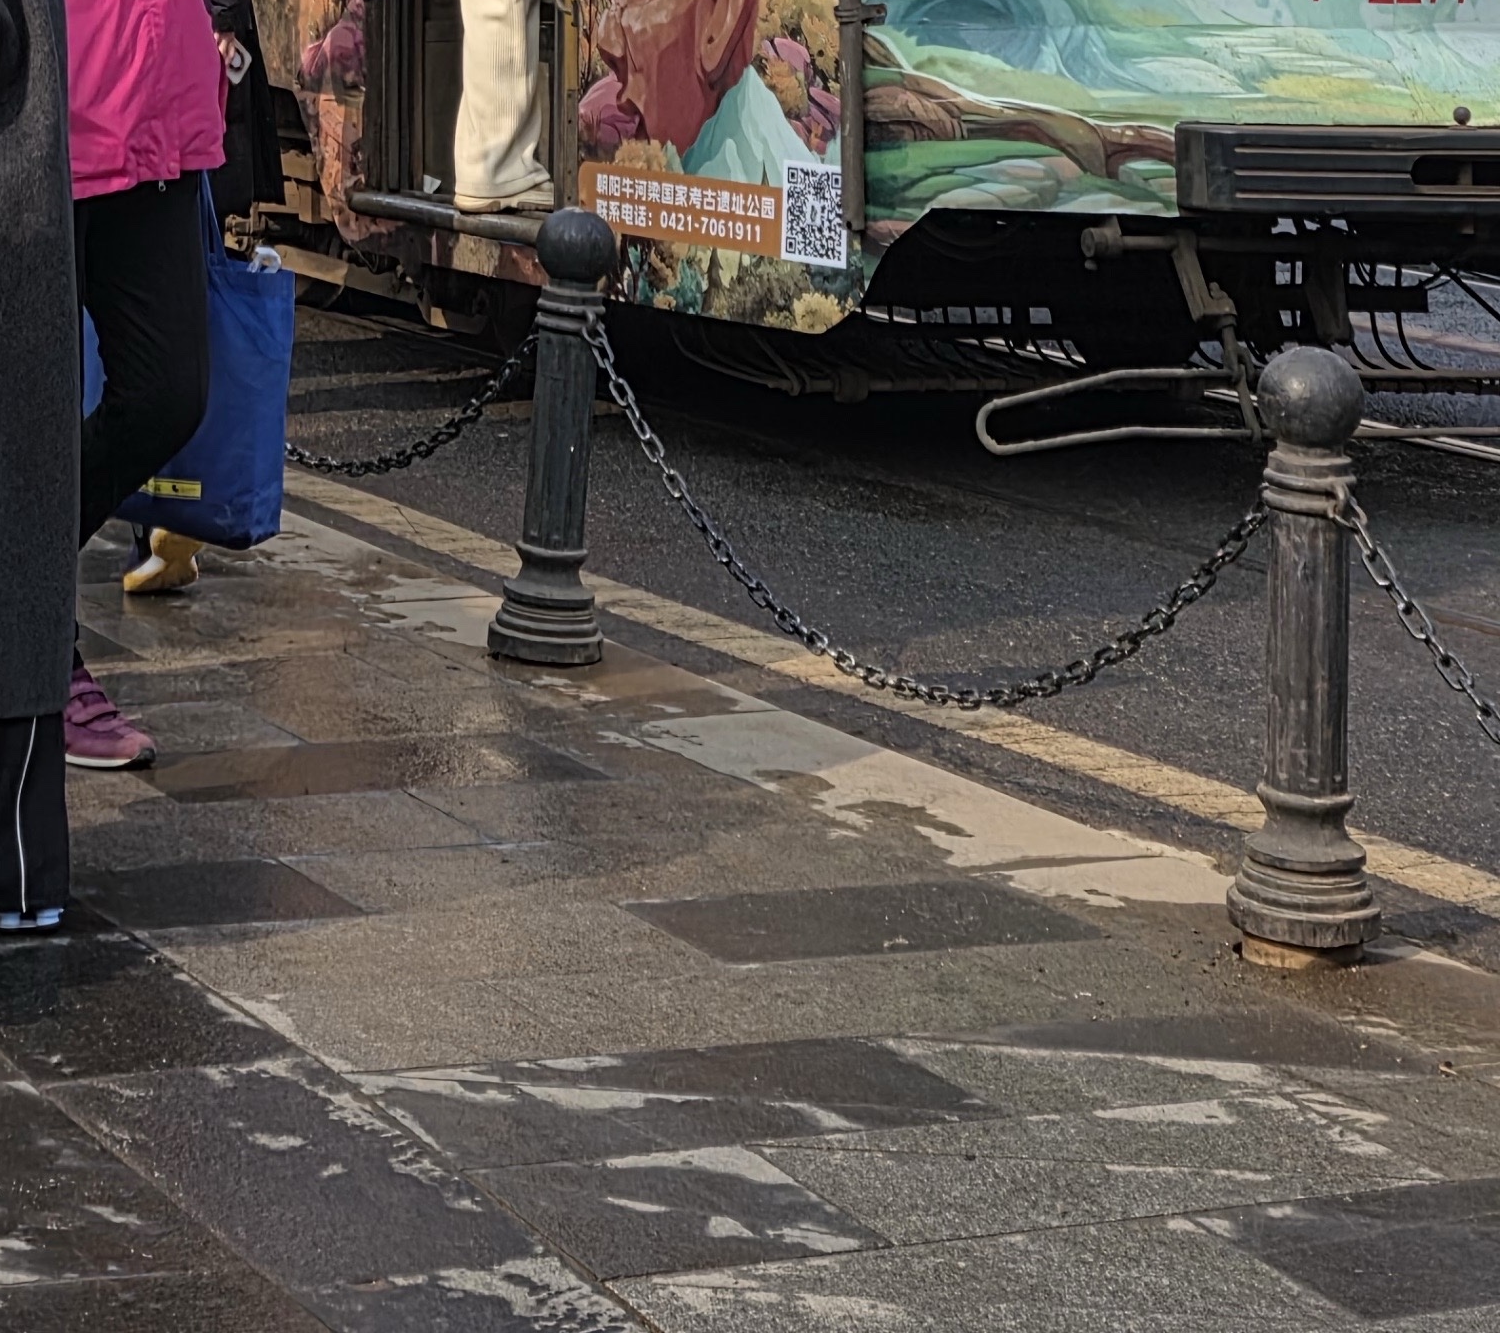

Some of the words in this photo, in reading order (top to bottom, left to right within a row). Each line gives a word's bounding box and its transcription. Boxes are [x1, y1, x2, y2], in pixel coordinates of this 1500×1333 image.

[596, 173, 775, 220] 朝阳牛河梁国家考古遗址公园
